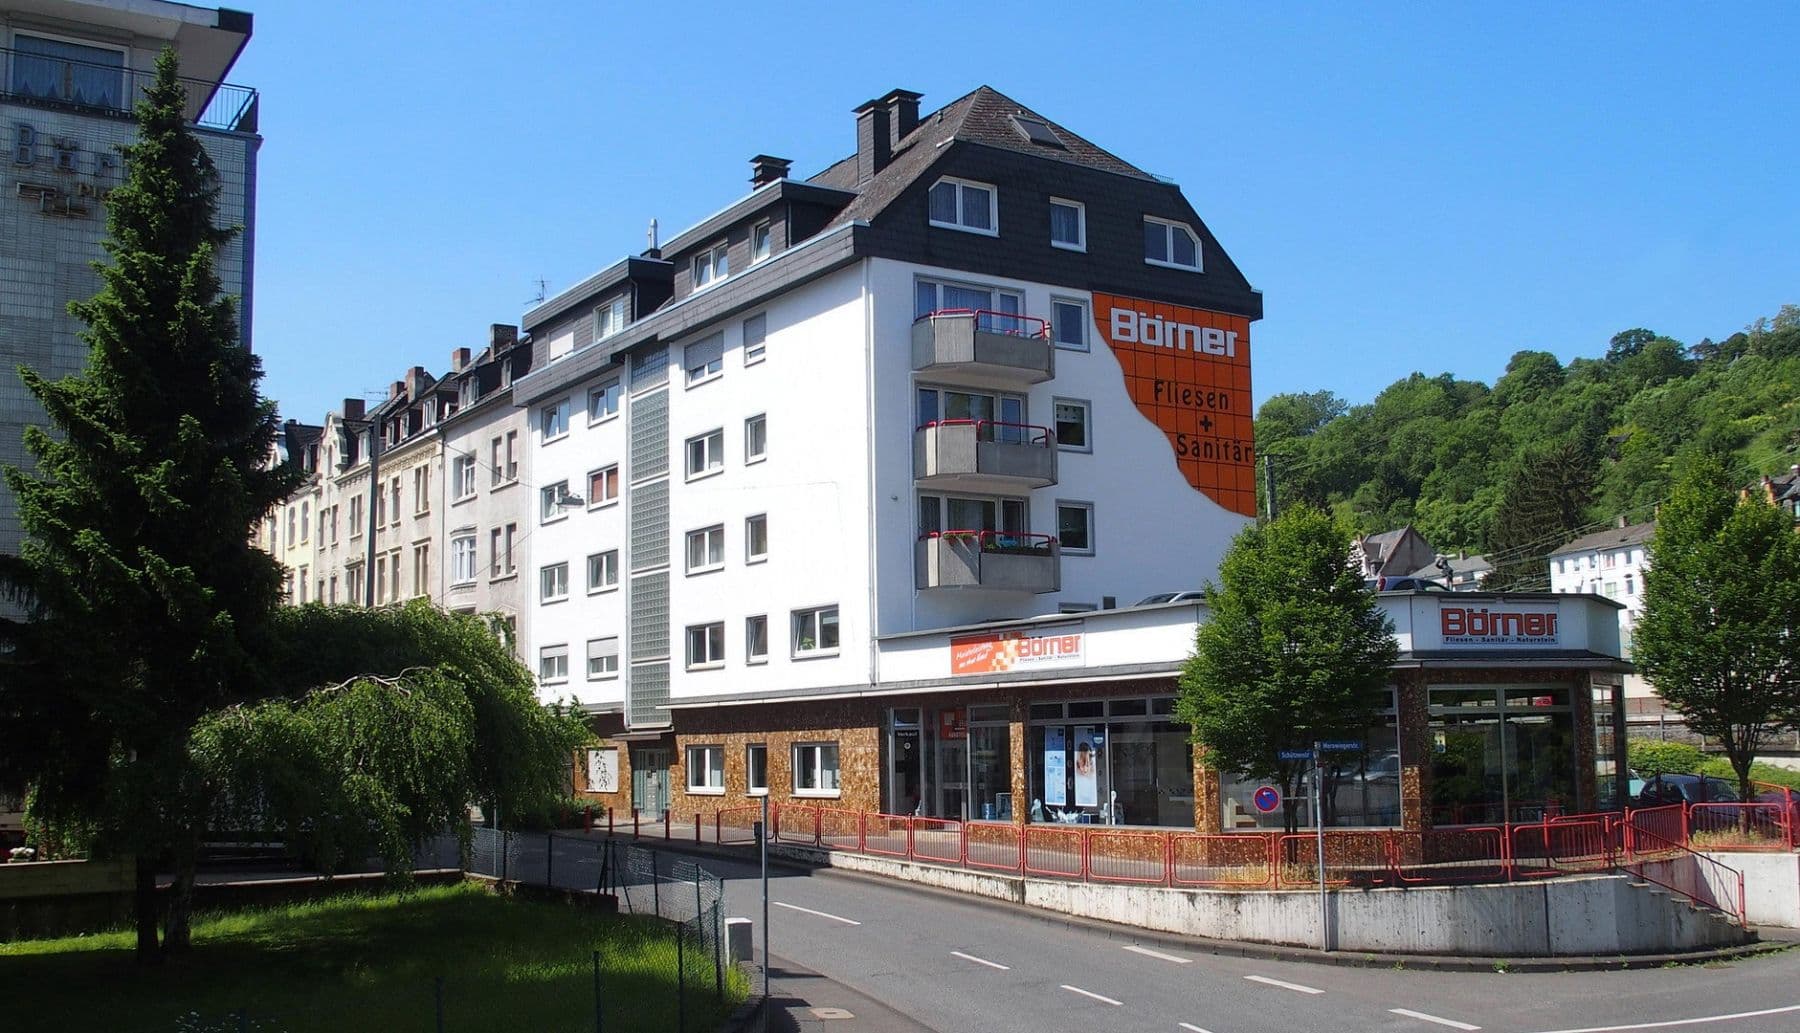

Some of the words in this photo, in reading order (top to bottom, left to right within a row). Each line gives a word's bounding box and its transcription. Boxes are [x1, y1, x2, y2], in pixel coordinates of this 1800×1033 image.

[1110, 307, 1238, 358] Börner
[1155, 378, 1229, 410] Fliesen
[1176, 432, 1253, 463] Sanitär
[1441, 608, 1557, 636] Börner
[1018, 635, 1081, 657] Börner
